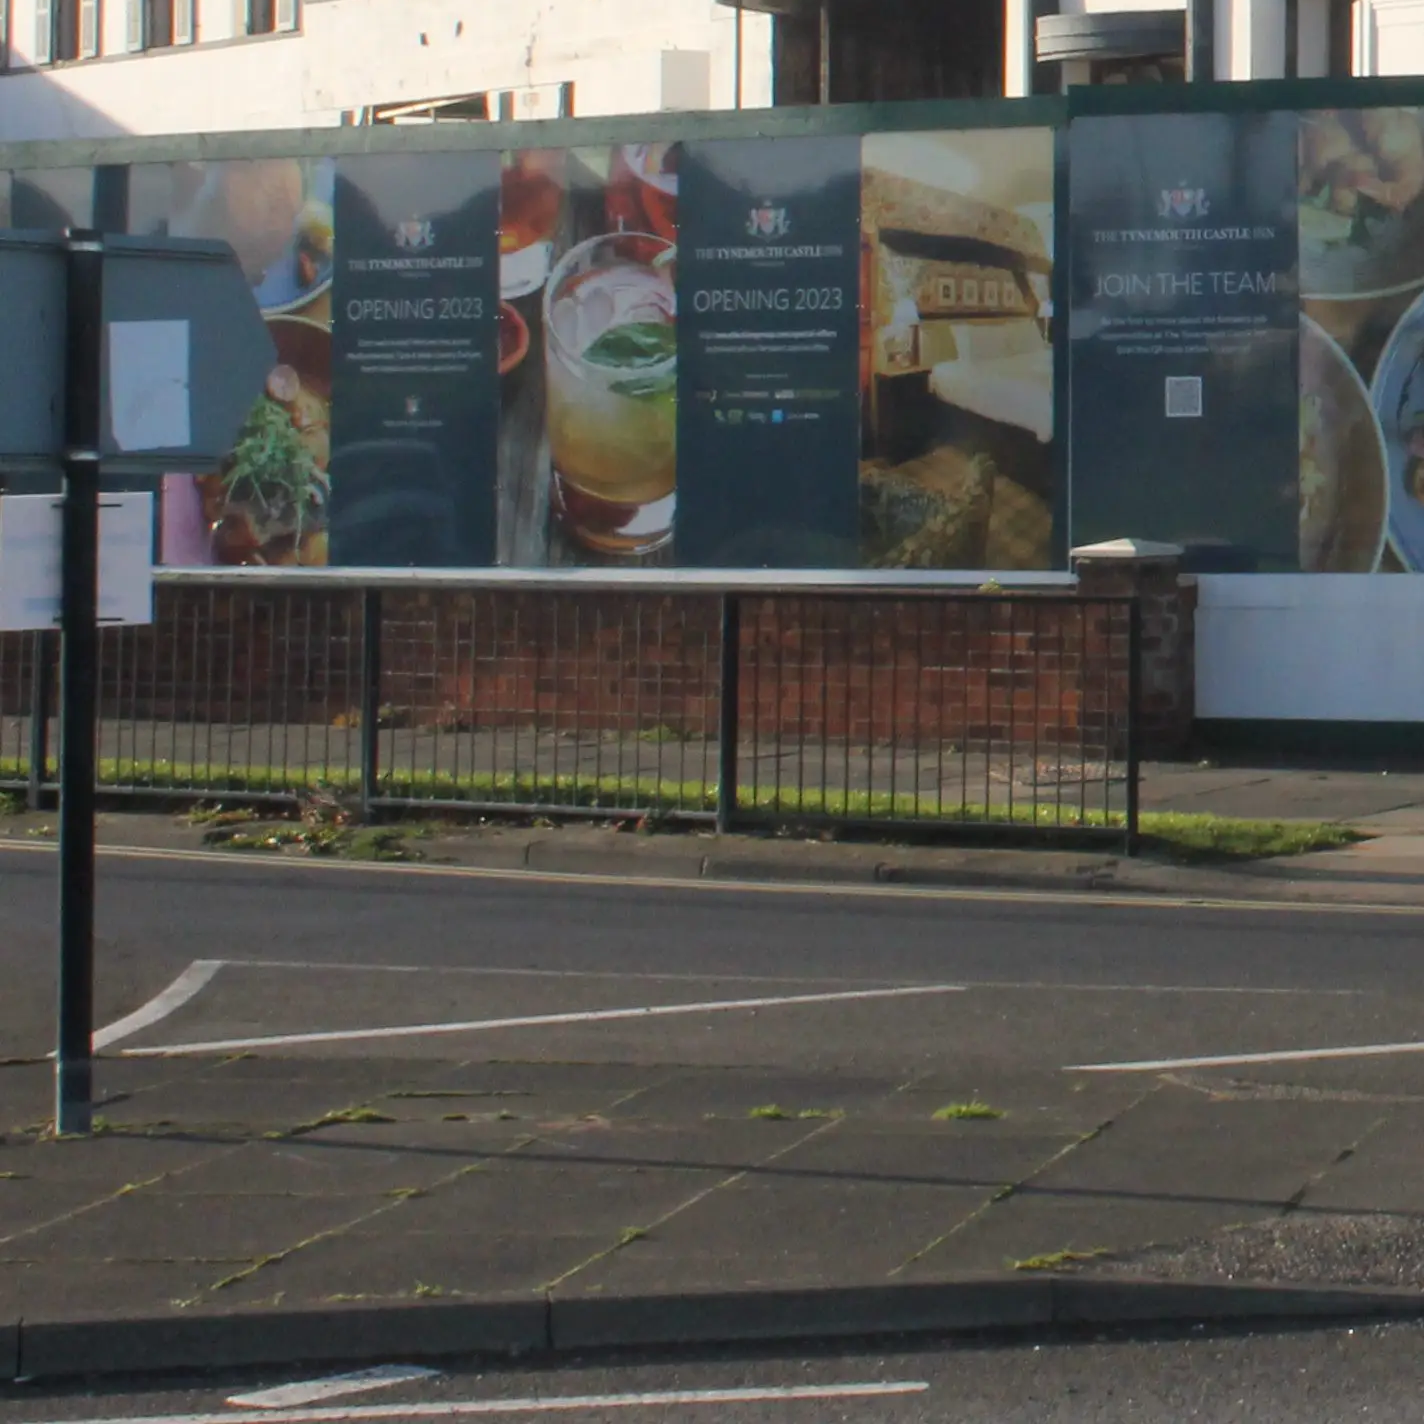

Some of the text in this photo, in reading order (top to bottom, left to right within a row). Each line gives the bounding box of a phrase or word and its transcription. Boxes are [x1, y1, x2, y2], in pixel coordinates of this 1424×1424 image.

[1120, 229, 1202, 241] TYNEMOUTH
[1203, 228, 1251, 240] CASTLE
[716, 246, 783, 259] TYNEMOUTH
[784, 244, 820, 258] CASTLE
[1094, 271, 1276, 298] JOIN THE TEAM
[346, 296, 484, 321] OPENING 2023
[693, 287, 843, 312] OPENING 2023
